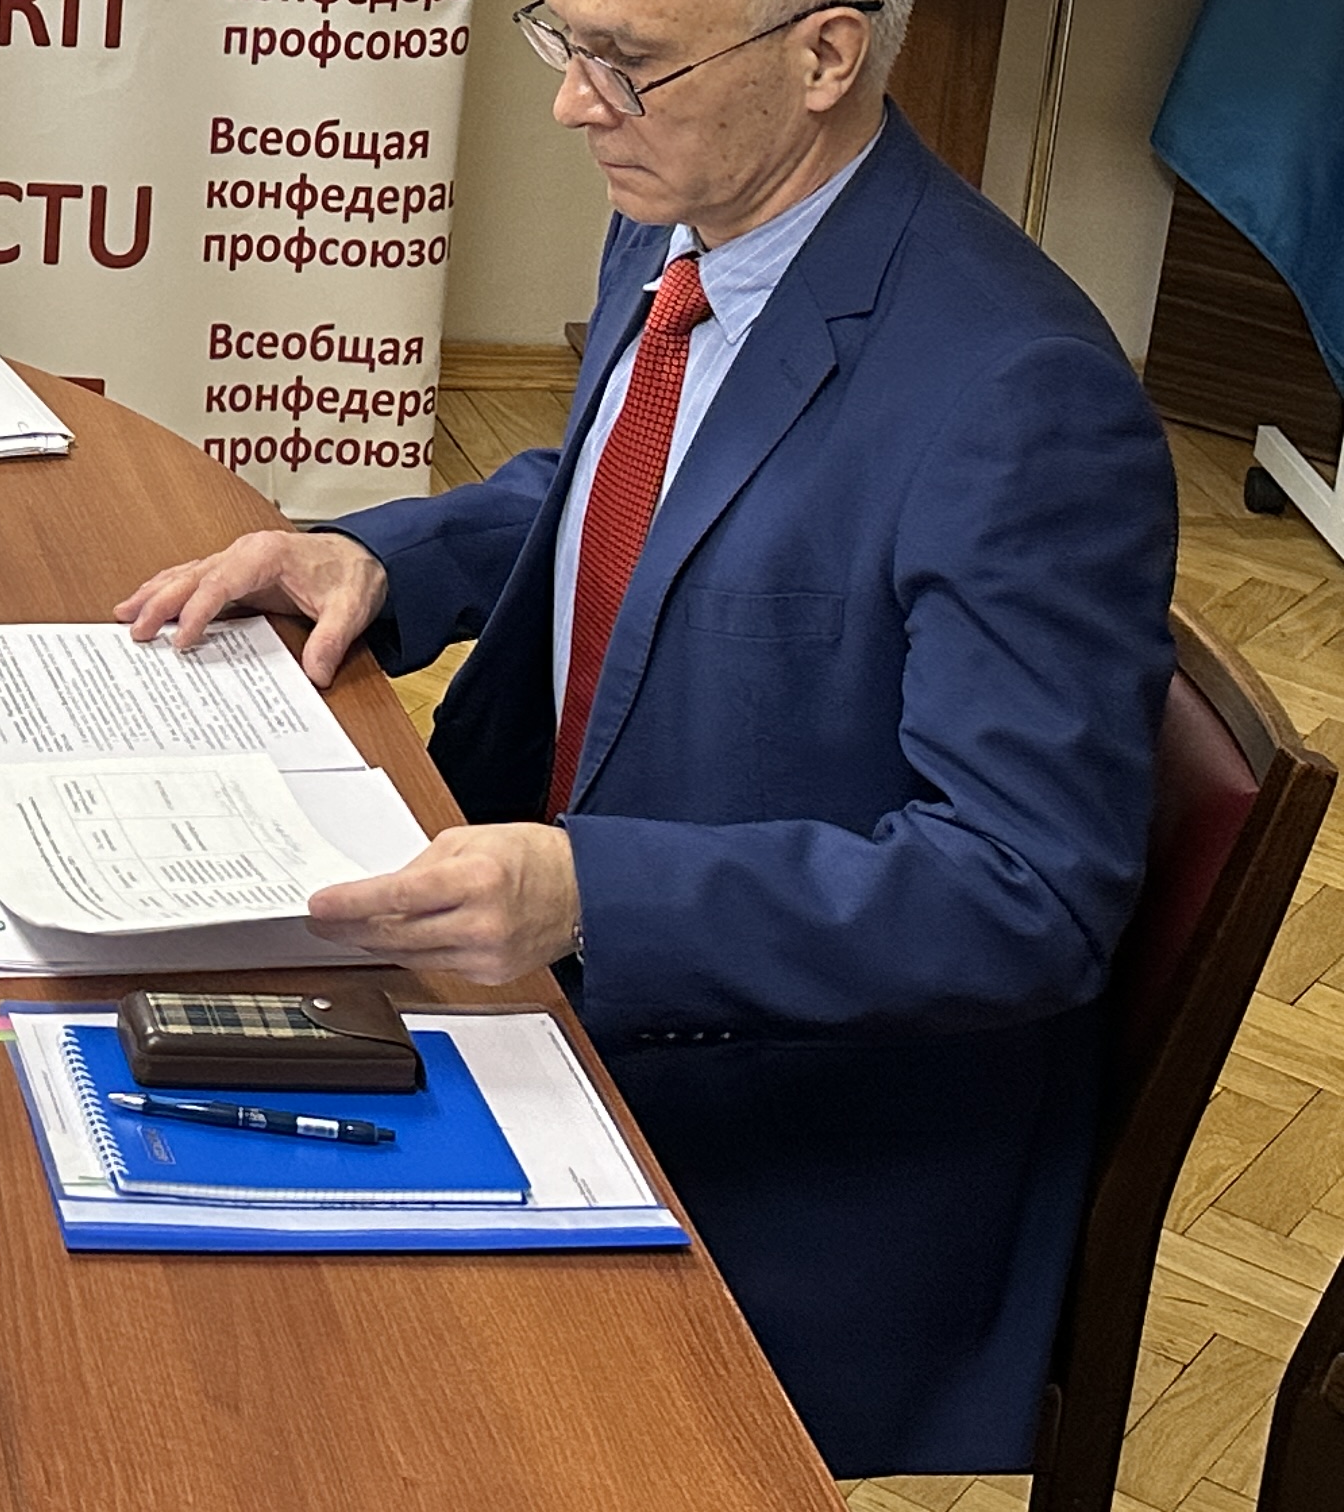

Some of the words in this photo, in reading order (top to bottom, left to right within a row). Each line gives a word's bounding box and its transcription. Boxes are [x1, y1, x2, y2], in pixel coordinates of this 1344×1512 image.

[223, 20, 470, 67] профсоюзо
[209, 116, 430, 169] Всеобщая
[206, 173, 454, 224] конфедера
[202, 226, 452, 273] профсоюзо
[208, 322, 424, 374] Всеобщая
[204, 374, 437, 428] конфедера
